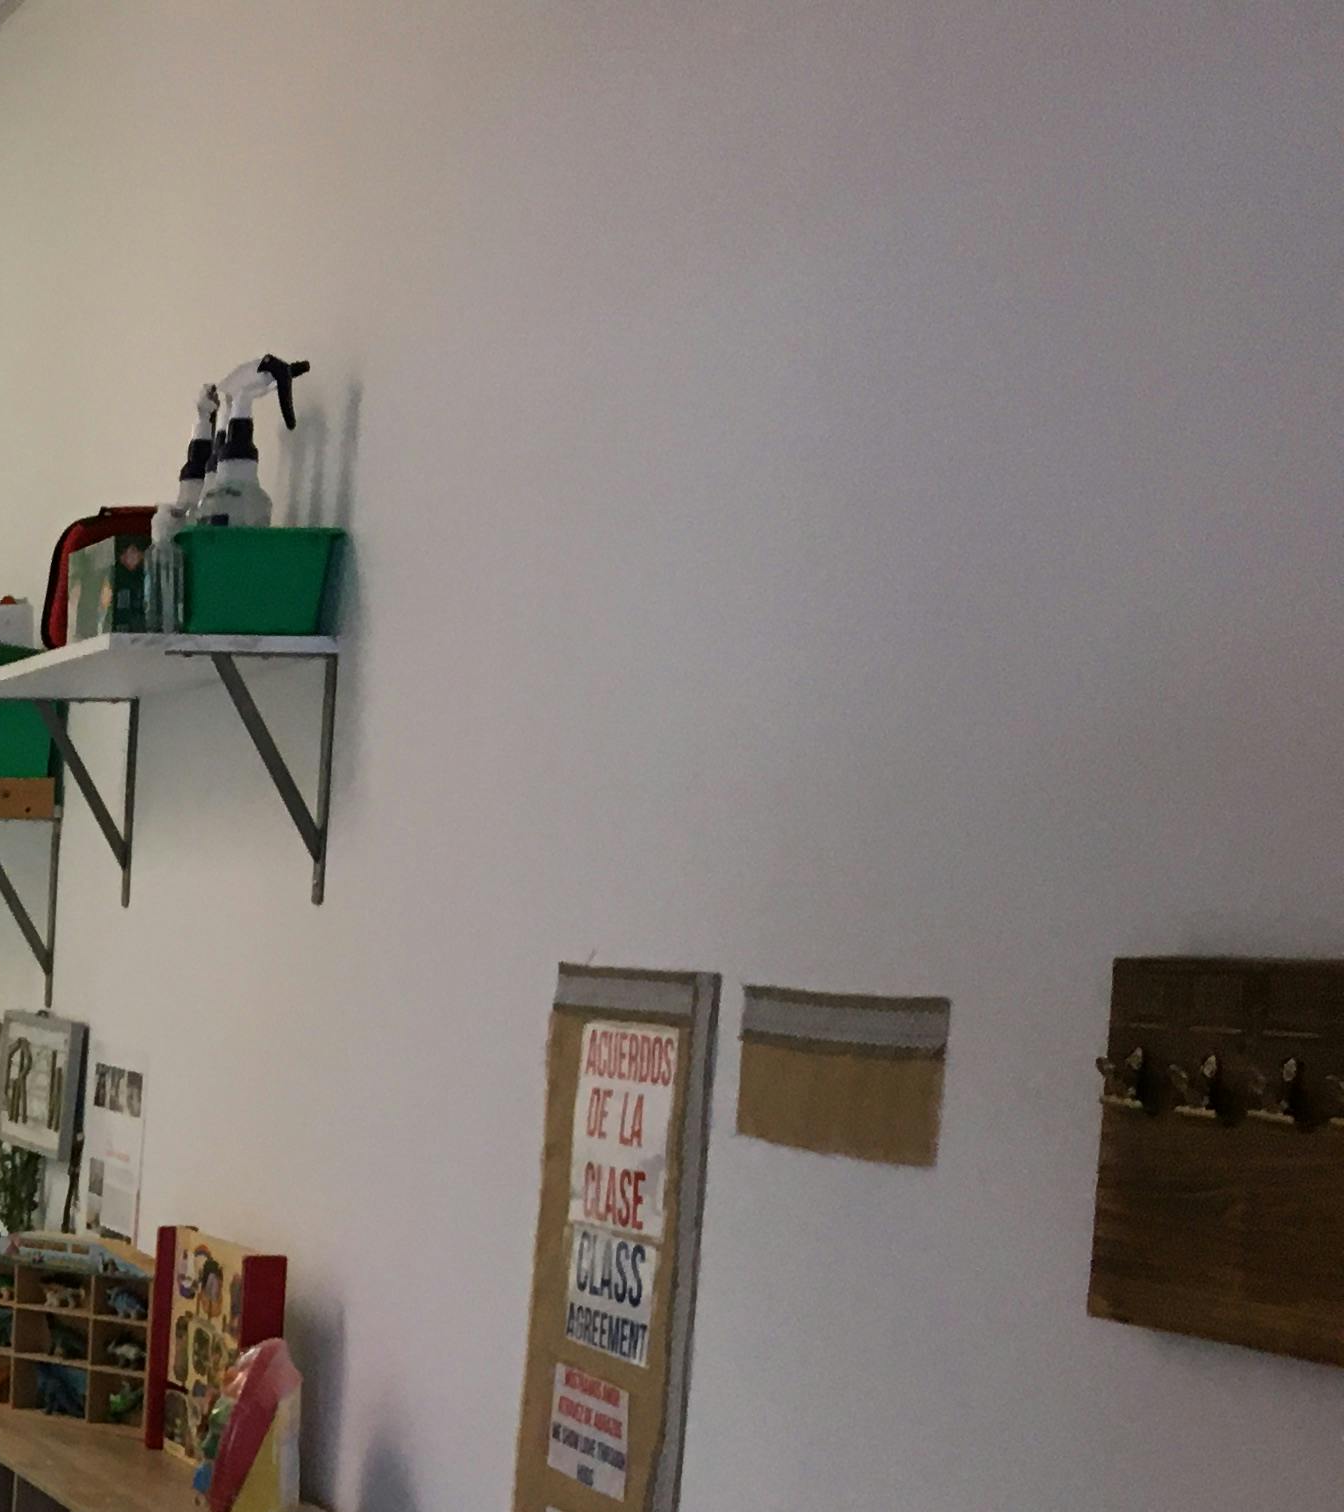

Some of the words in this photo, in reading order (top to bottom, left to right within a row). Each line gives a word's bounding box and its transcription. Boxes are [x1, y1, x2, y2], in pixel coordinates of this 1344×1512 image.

[585, 1029, 674, 1086] ACUERDOS
[586, 1087, 613, 1139] DE
[619, 1091, 644, 1148] LA
[583, 1161, 646, 1230] CLASE
[576, 1230, 646, 1308] CLASS
[566, 1302, 648, 1362] AGREEMENT
